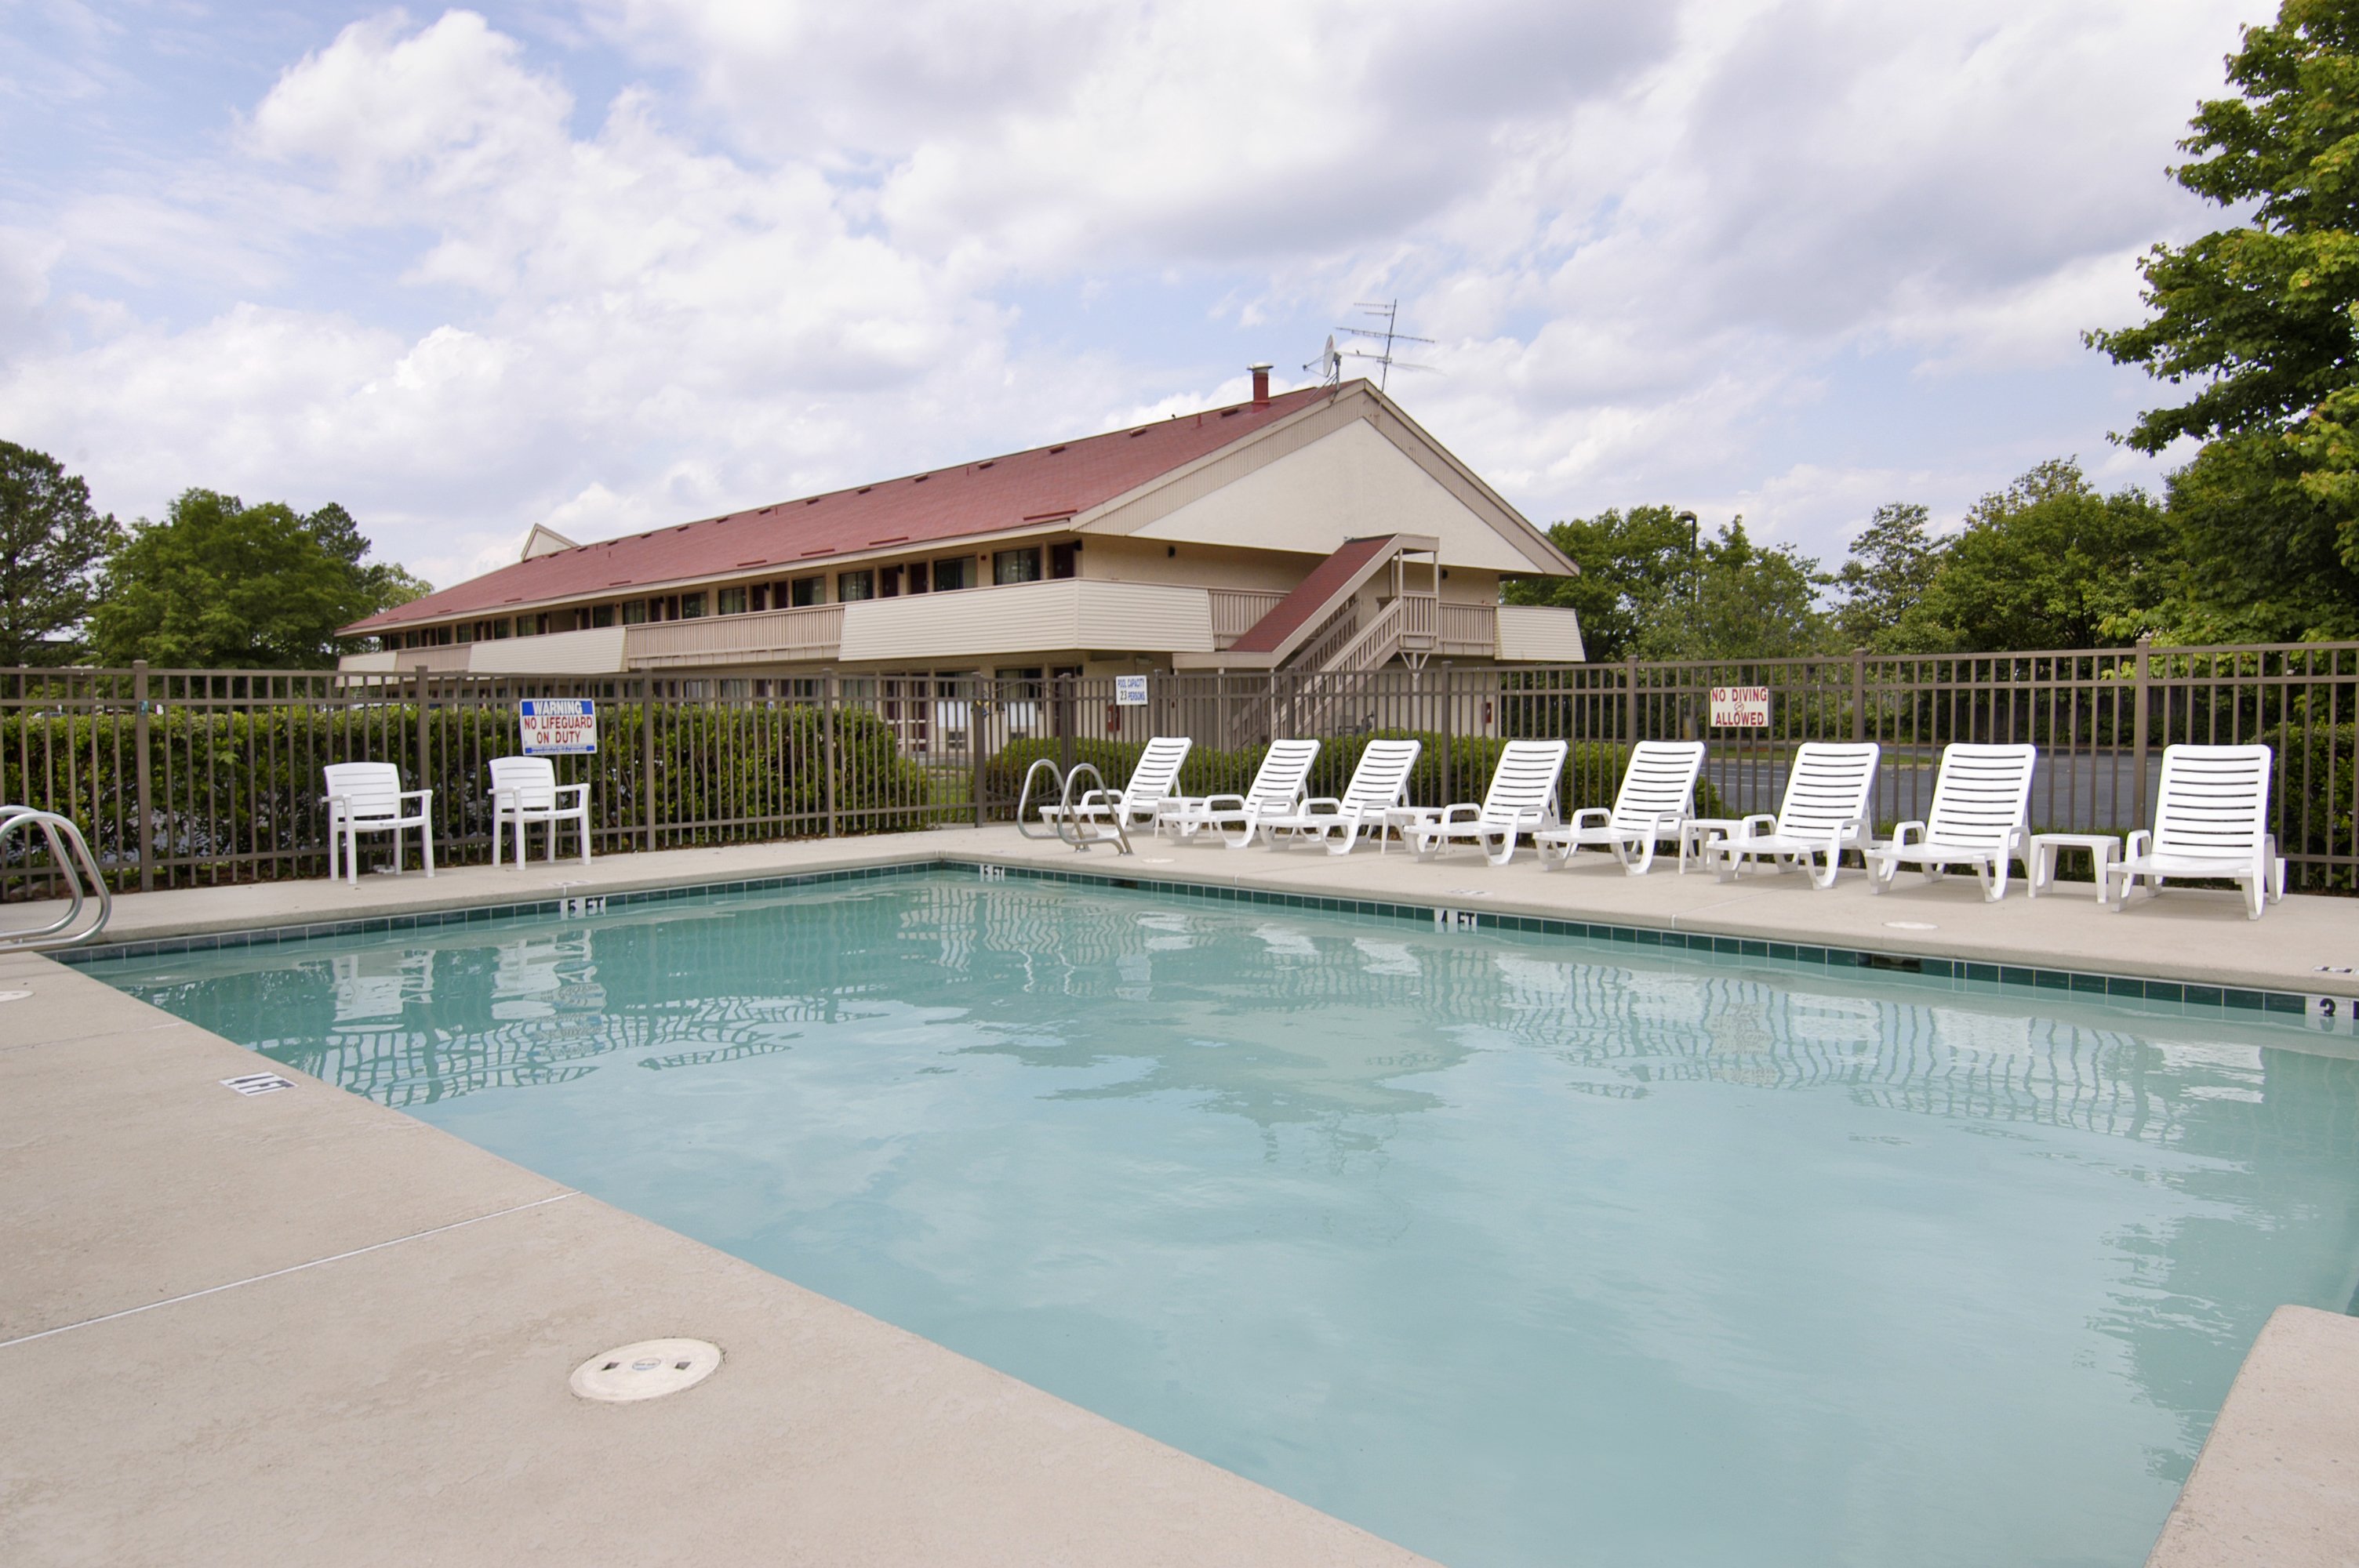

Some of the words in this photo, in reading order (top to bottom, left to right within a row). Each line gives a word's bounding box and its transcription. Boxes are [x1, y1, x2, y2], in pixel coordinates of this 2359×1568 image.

[1118, 678, 1126, 688] POOL
[1128, 677, 1145, 688] CAPACITY
[1121, 690, 1127, 700] 23
[1129, 691, 1145, 701] PERSONS
[1712, 688, 1725, 702] NO
[1732, 688, 1767, 702] DIVING
[533, 701, 583, 715] WARNING
[525, 717, 536, 729] NO
[542, 717, 592, 729] LIFEGUARD
[1716, 712, 1764, 725] ALLOWED
[537, 731, 550, 744] ON
[556, 731, 580, 743] DUTY
[568, 899, 576, 911] 5
[585, 896, 604, 909] FT
[1457, 911, 1475, 925] FT
